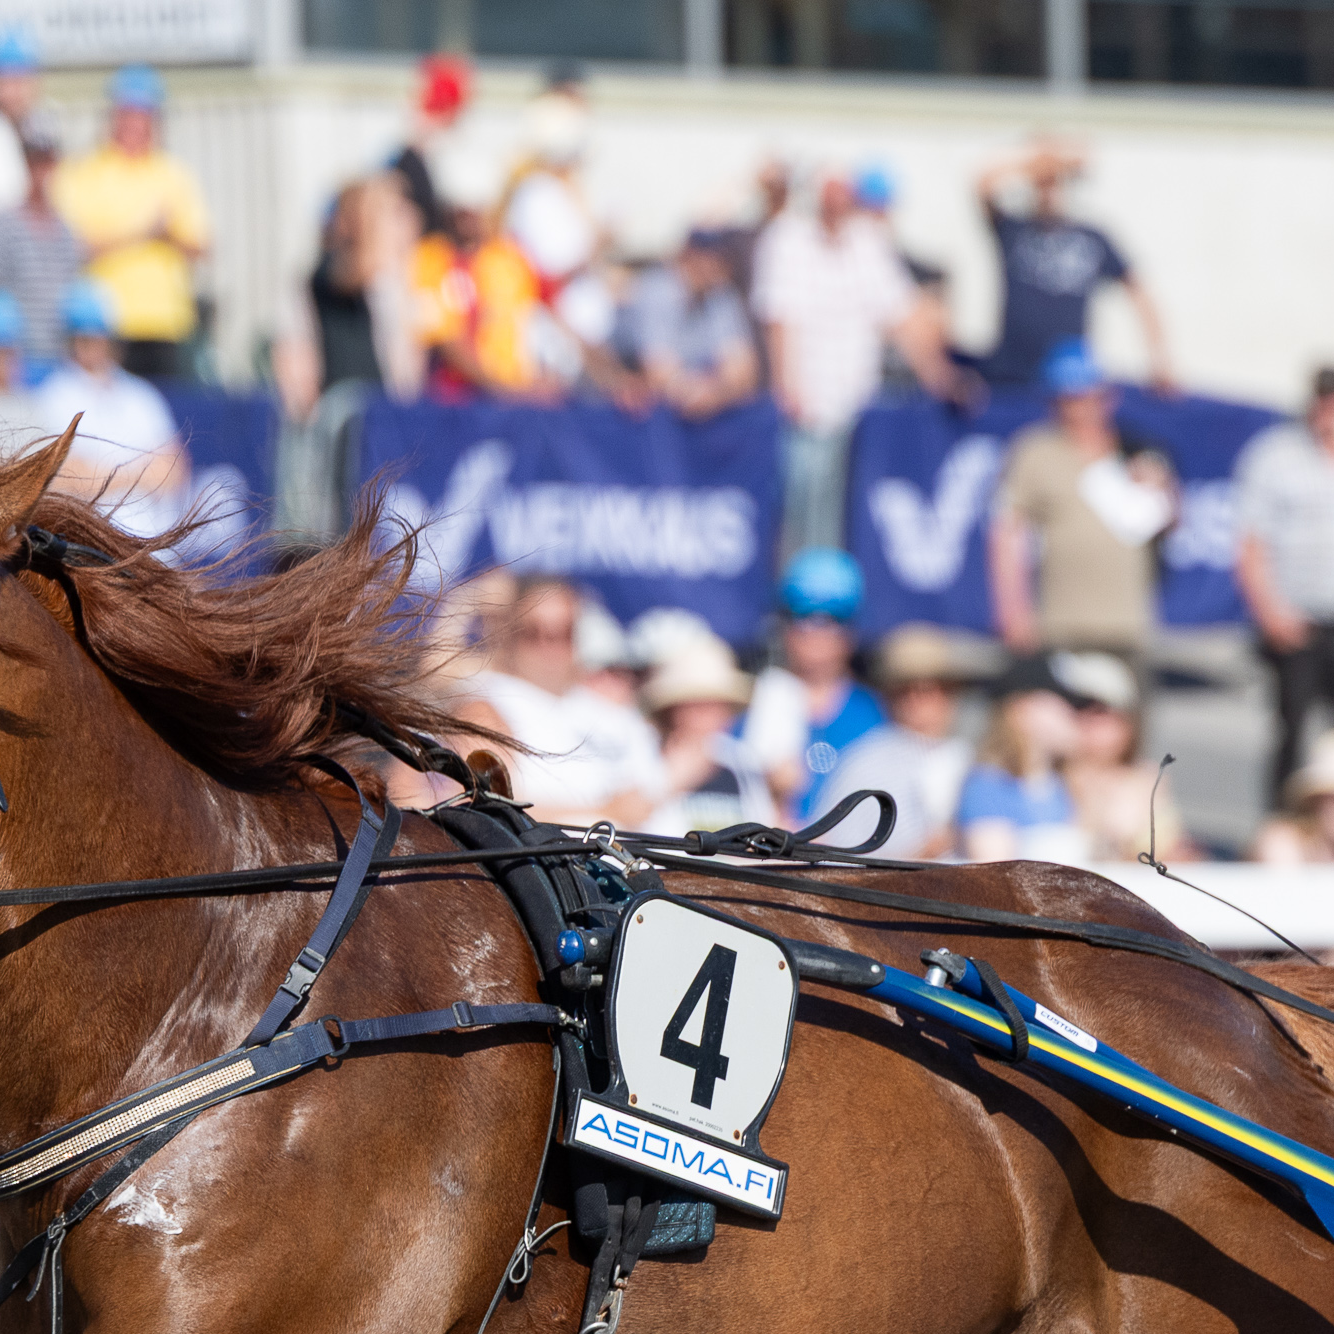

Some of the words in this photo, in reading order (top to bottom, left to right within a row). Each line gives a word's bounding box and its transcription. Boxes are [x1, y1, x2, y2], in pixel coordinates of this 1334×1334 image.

[660, 943, 738, 1110] 4
[1040, 1010, 1079, 1037] CUSTOM
[581, 1113, 774, 1199] ASOMA.FI
